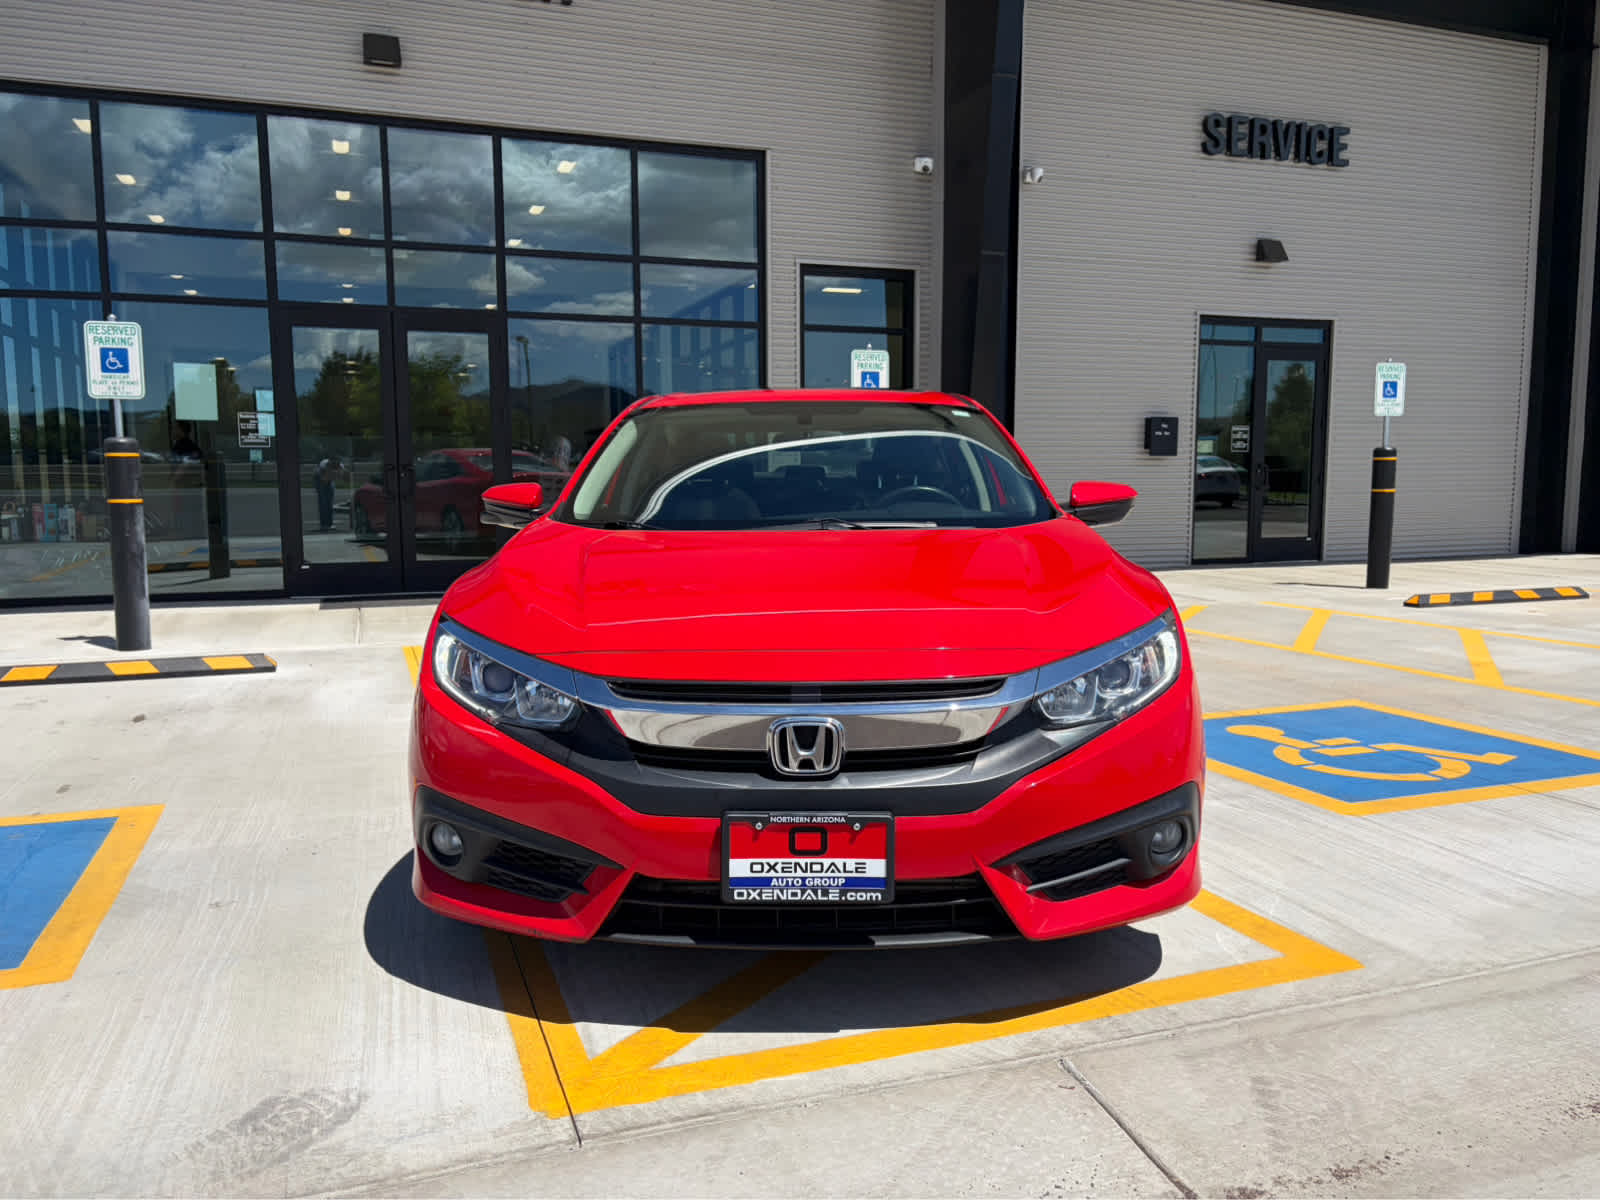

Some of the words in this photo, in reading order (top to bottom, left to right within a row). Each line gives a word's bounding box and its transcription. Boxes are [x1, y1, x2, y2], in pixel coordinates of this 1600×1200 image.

[1201, 112, 1350, 167] SERVICE
[88, 325, 137, 336] RESERVED
[93, 336, 134, 346] PARKING
[857, 362, 883, 370] PARKING
[749, 861, 867, 874] OXENDALE
[770, 877, 802, 887] AUTO
[805, 877, 846, 887] GROUP
[733, 889, 882, 901] OXENDALE.com
